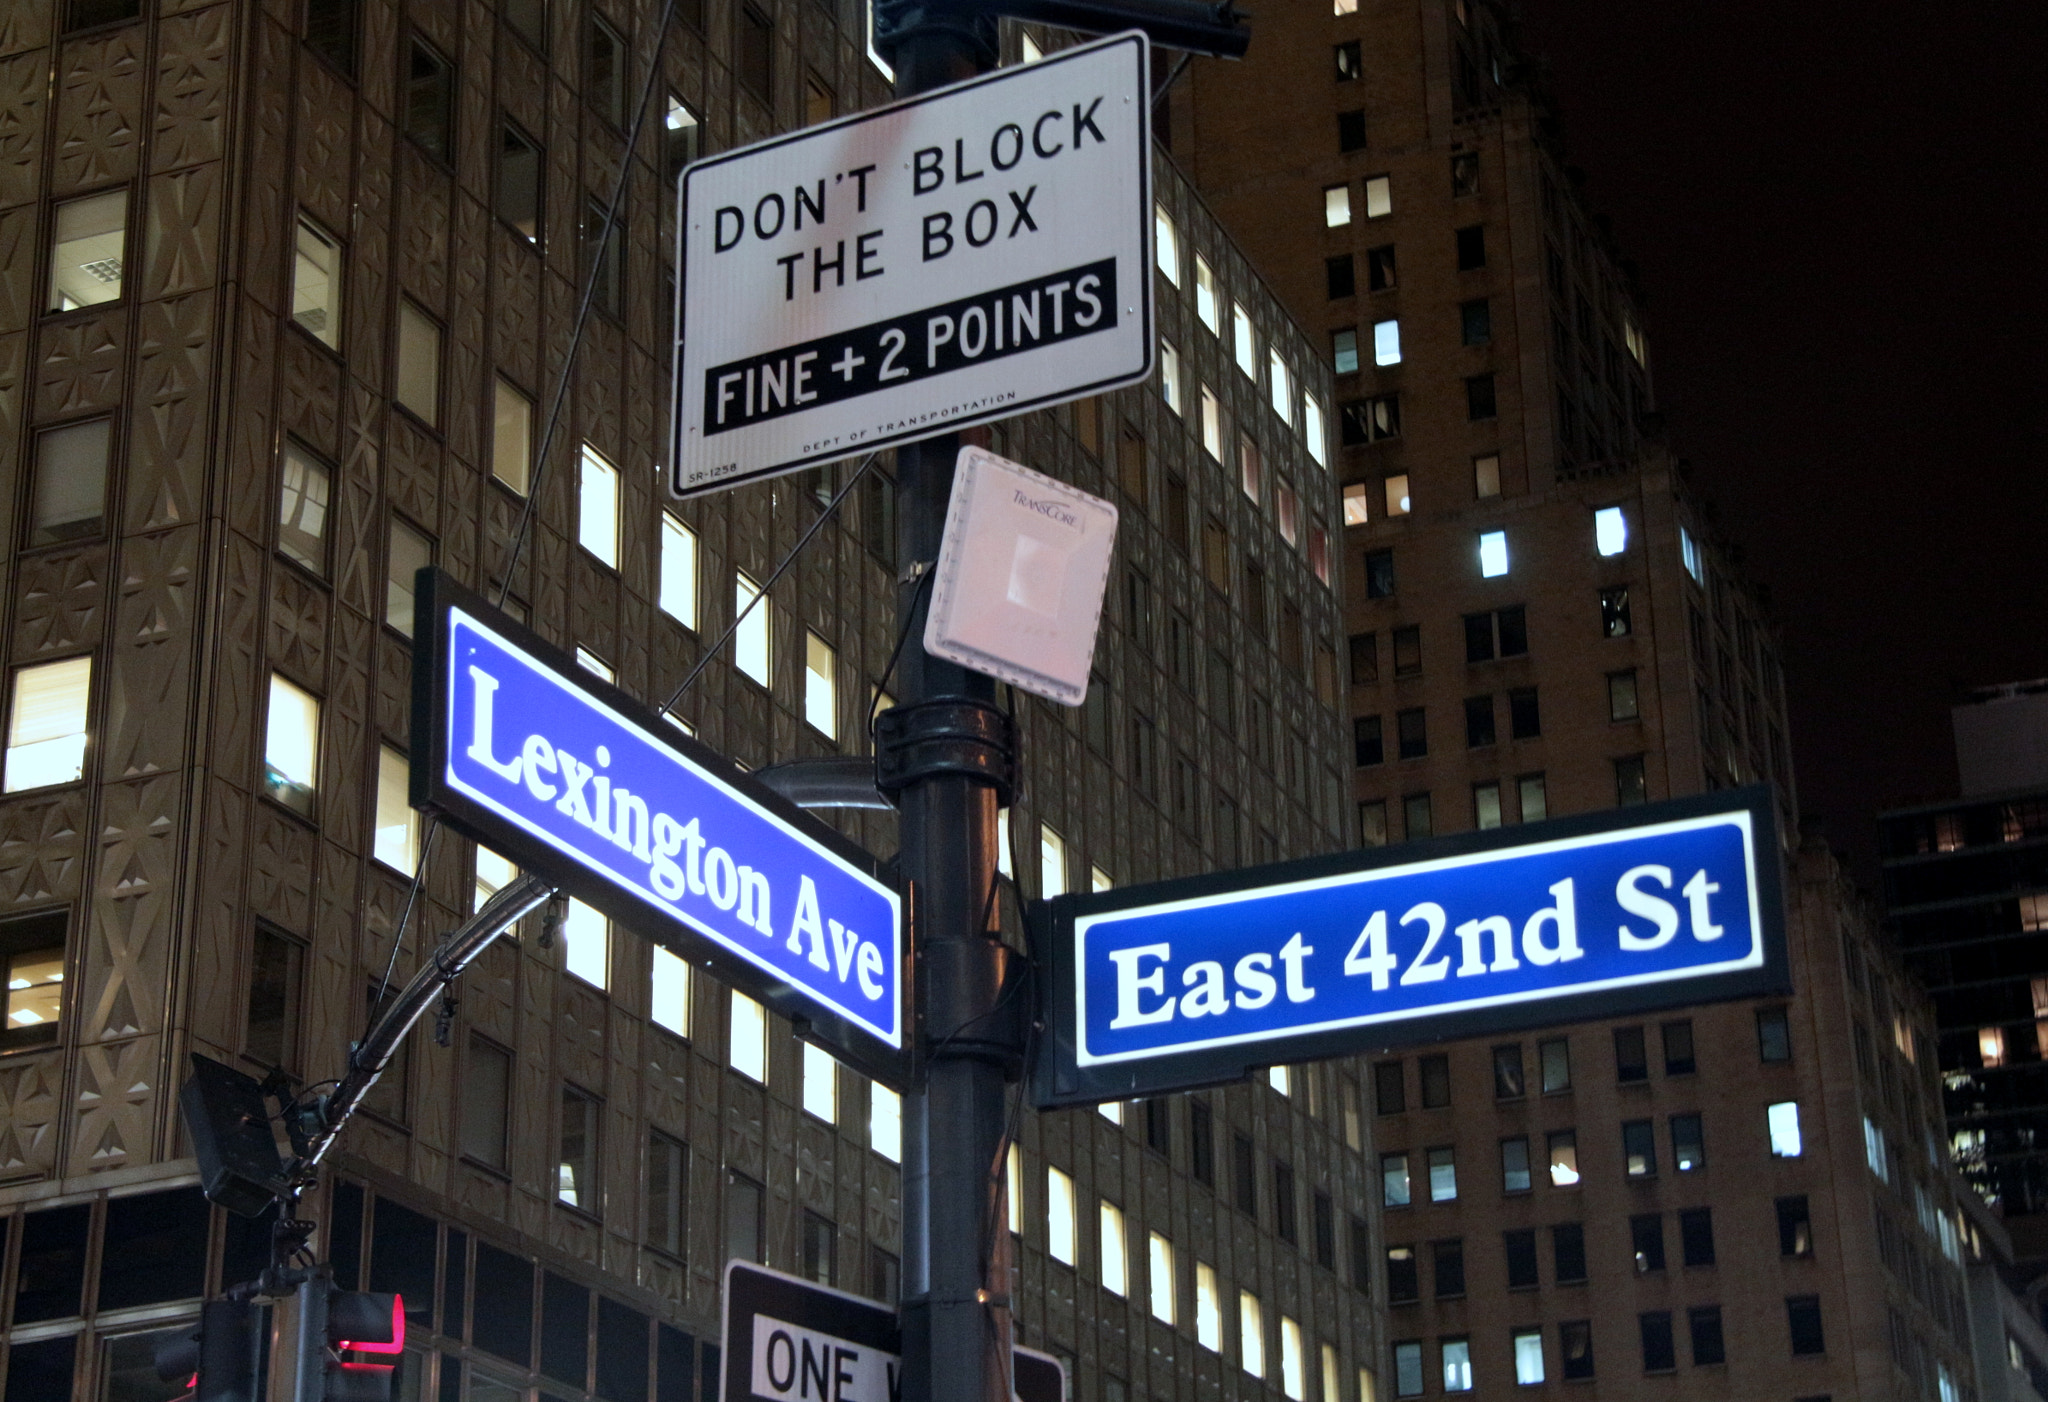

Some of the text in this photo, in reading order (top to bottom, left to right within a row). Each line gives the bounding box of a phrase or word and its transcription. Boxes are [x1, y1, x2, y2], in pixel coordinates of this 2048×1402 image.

[715, 97, 1106, 254] DON'T BLOCK
[777, 185, 1038, 301] THE BOX
[717, 351, 818, 424] FINE
[878, 328, 910, 382] 2
[928, 274, 1102, 369] POINTS
[689, 463, 737, 483] SR-1258
[803, 391, 1016, 454] DEPT OF TRANSPORTATION
[467, 665, 884, 1001] Lexington Ave
[1109, 864, 1724, 1030] East 42nd St
[767, 1329, 858, 1402] ONE
